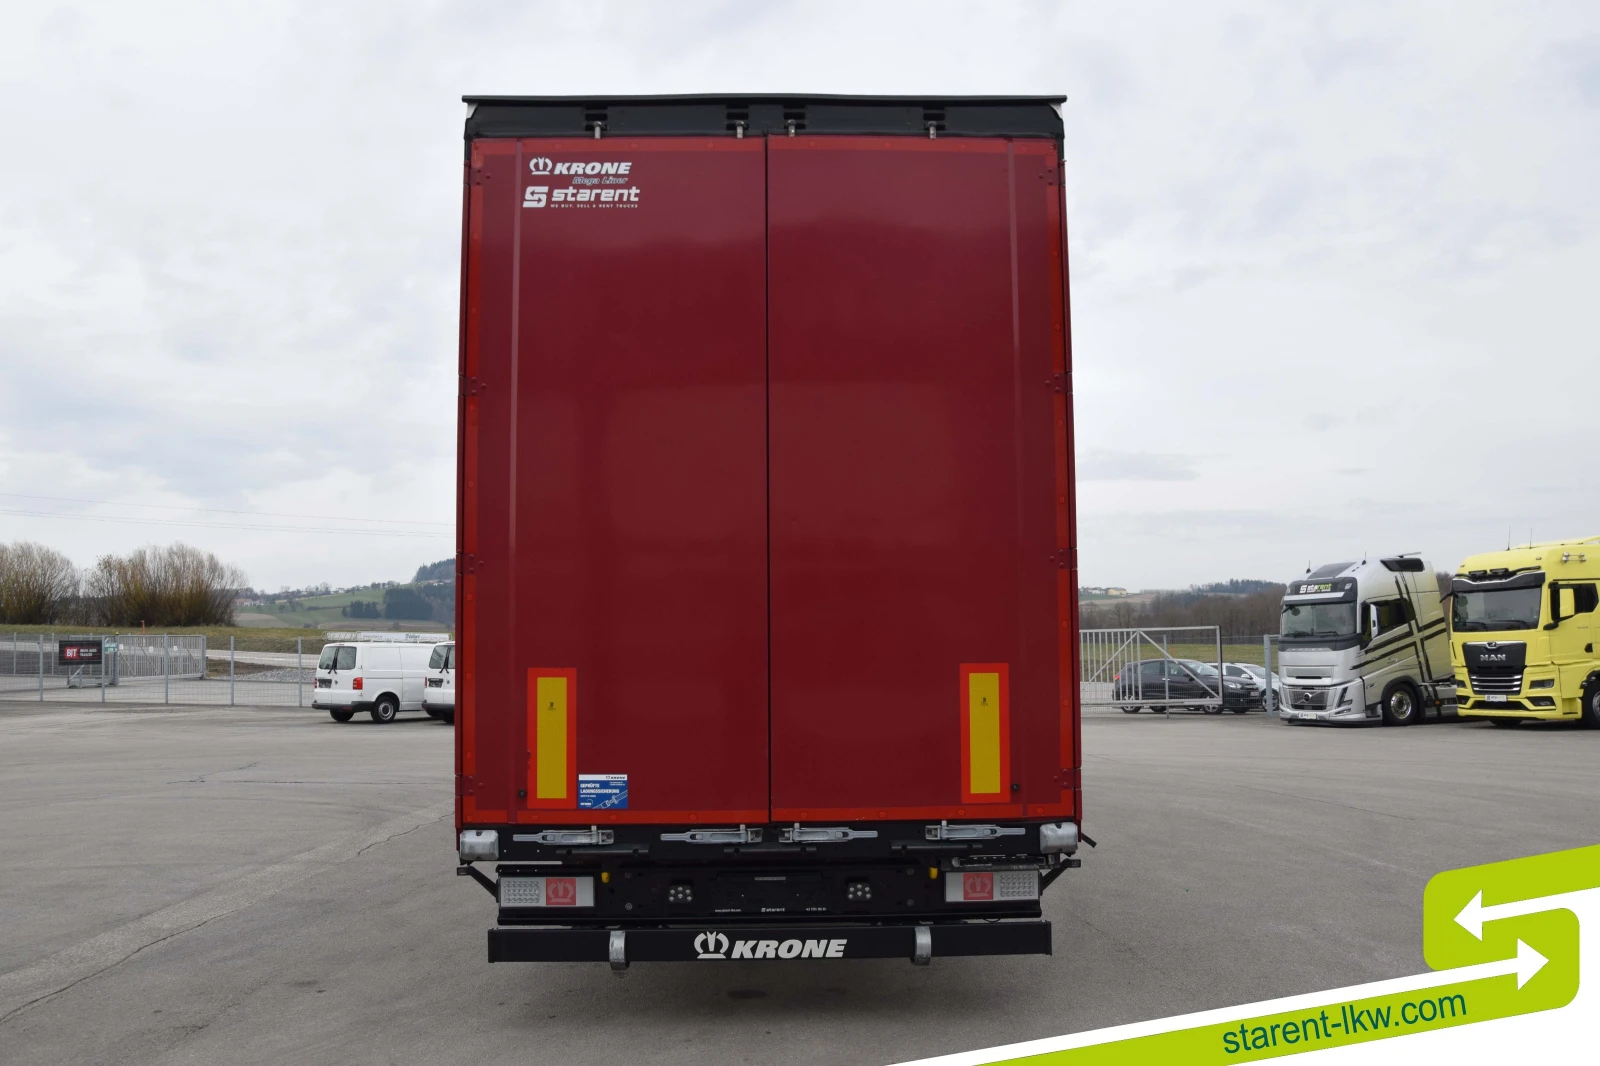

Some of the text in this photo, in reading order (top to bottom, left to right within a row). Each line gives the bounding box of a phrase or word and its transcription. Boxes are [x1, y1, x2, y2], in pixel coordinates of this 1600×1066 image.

[554, 162, 632, 175] KRONE
[572, 176, 628, 186] Mega Liner
[551, 186, 640, 202] starent
[731, 939, 847, 959] KRONE
